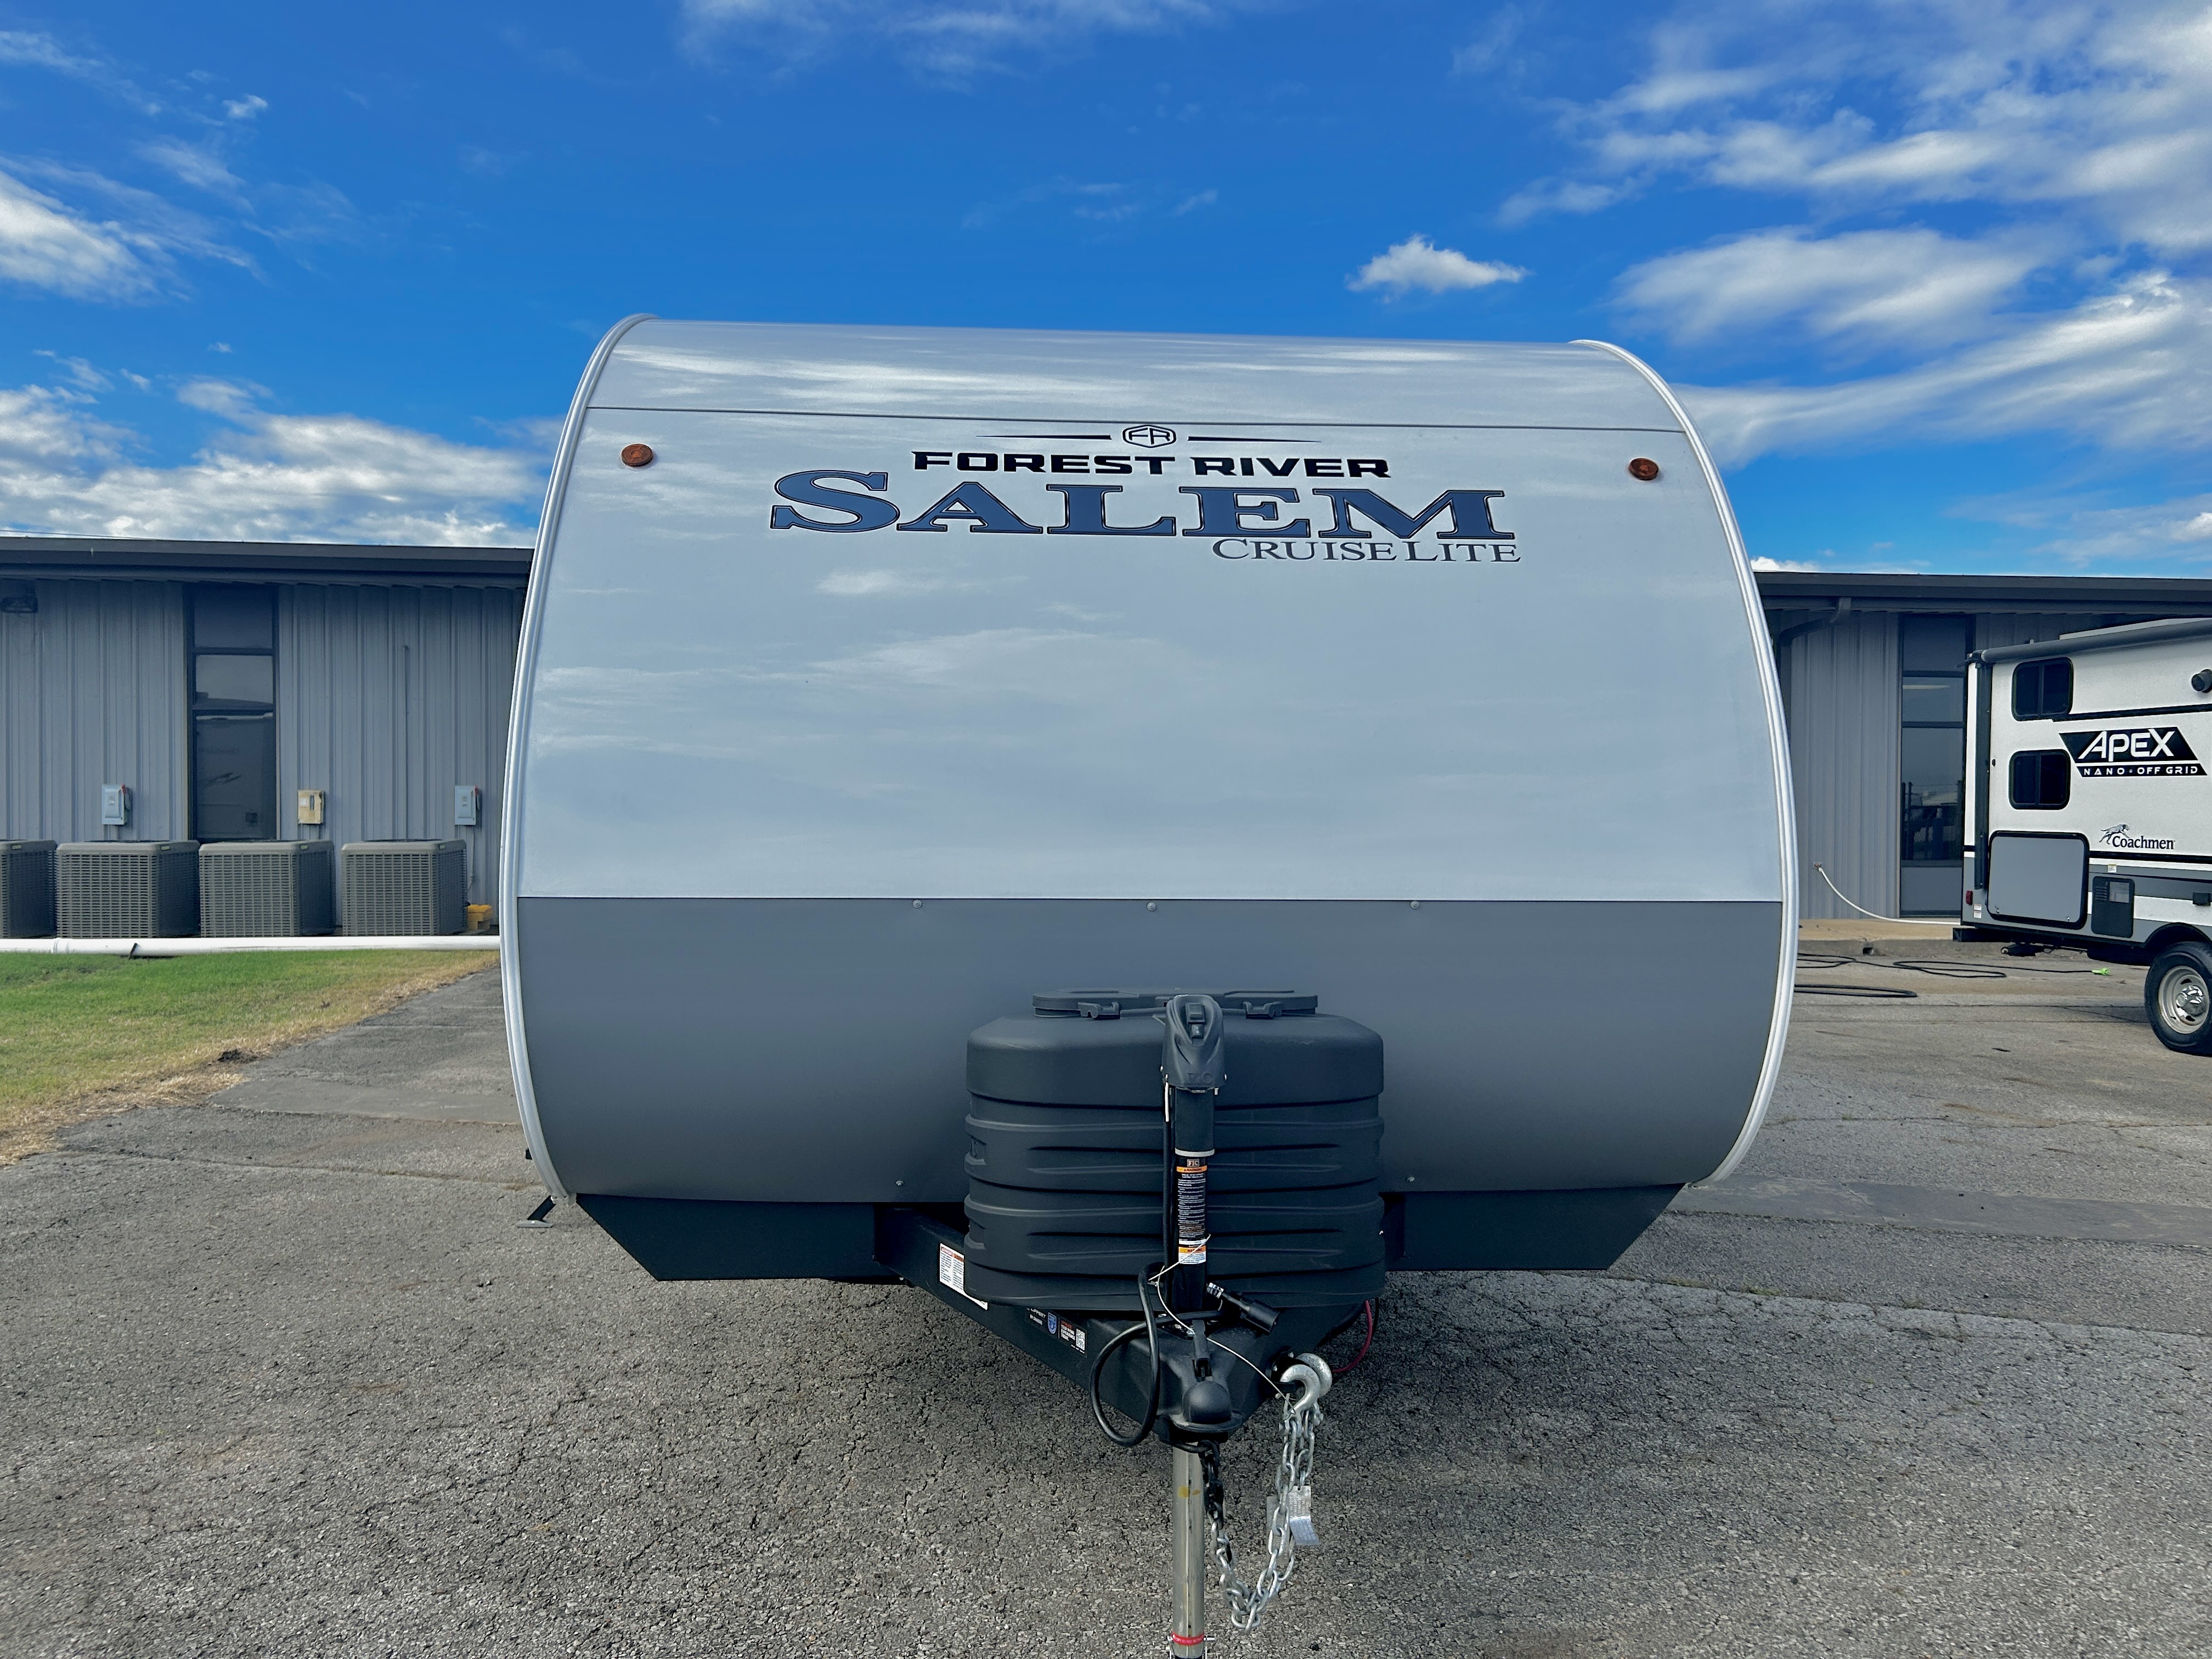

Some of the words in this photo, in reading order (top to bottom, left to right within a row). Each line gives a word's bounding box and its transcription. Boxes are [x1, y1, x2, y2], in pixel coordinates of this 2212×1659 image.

[1128, 427, 1170, 445] FR
[911, 450, 1175, 475] FOREST
[1189, 456, 1392, 478] RIVER
[770, 470, 1515, 539] SALEM
[1212, 538, 1398, 561] CRUISE
[1404, 541, 1522, 563] LITE
[2078, 728, 2176, 761] APEX
[2137, 766, 2161, 775] OFF
[2165, 766, 2198, 774] GRID
[2112, 835, 2174, 850] Coachmen
